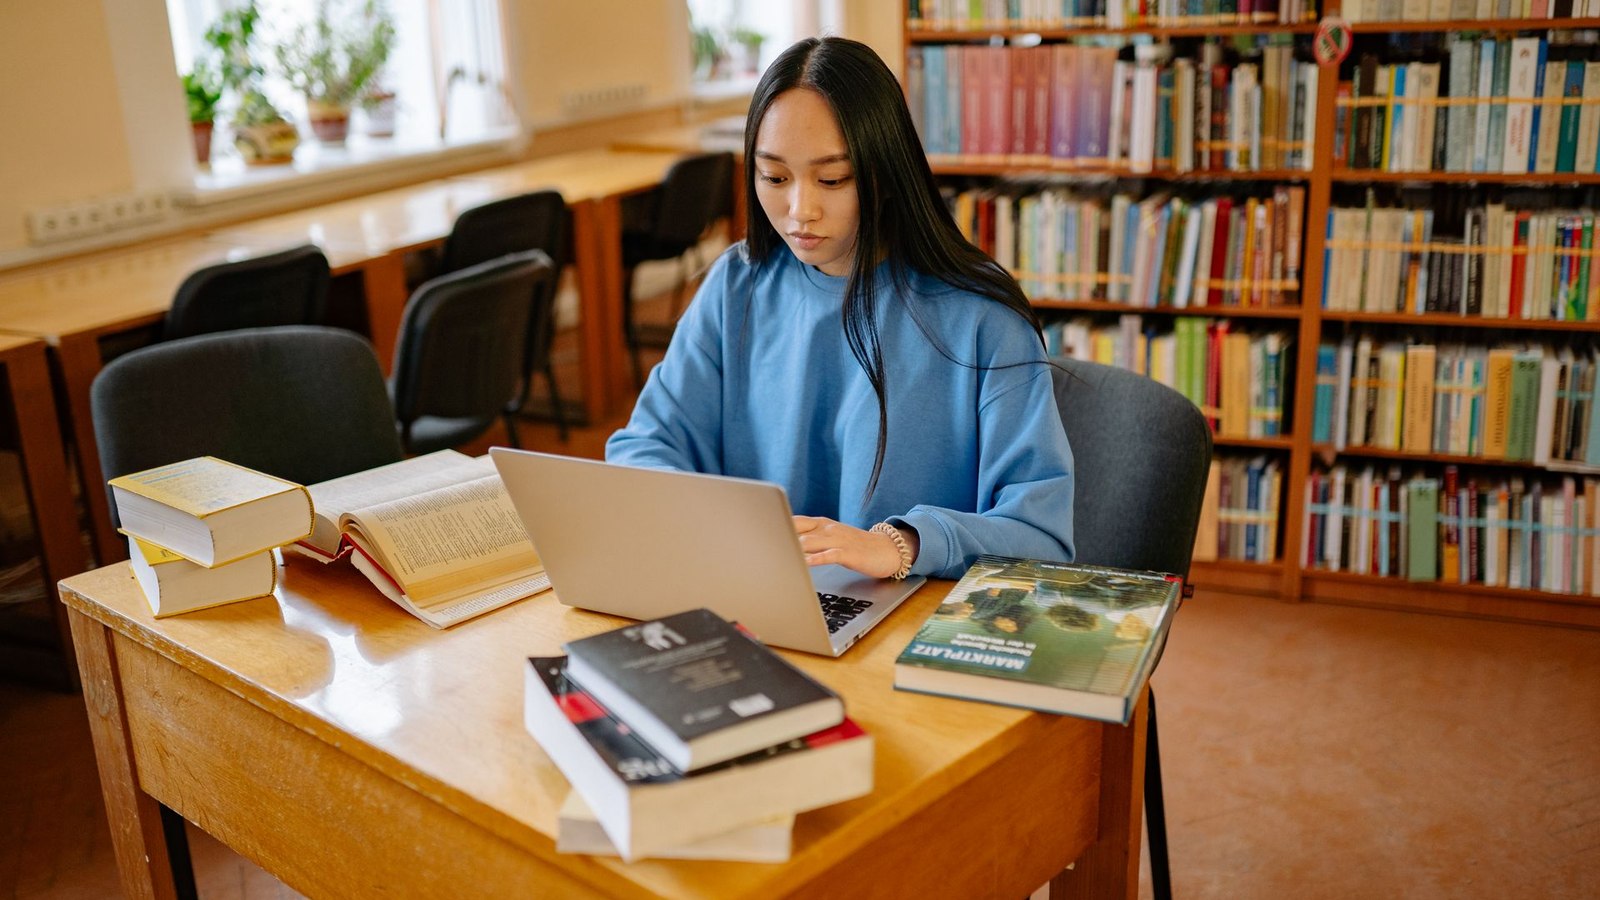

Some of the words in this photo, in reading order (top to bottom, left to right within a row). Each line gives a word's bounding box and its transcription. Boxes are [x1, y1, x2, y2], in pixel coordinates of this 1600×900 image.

[950, 639, 987, 650] Sprache
[957, 633, 1005, 645] Wirtschaft
[988, 644, 1032, 657] Deutsche
[911, 644, 1025, 670] MARKTPLATZ
